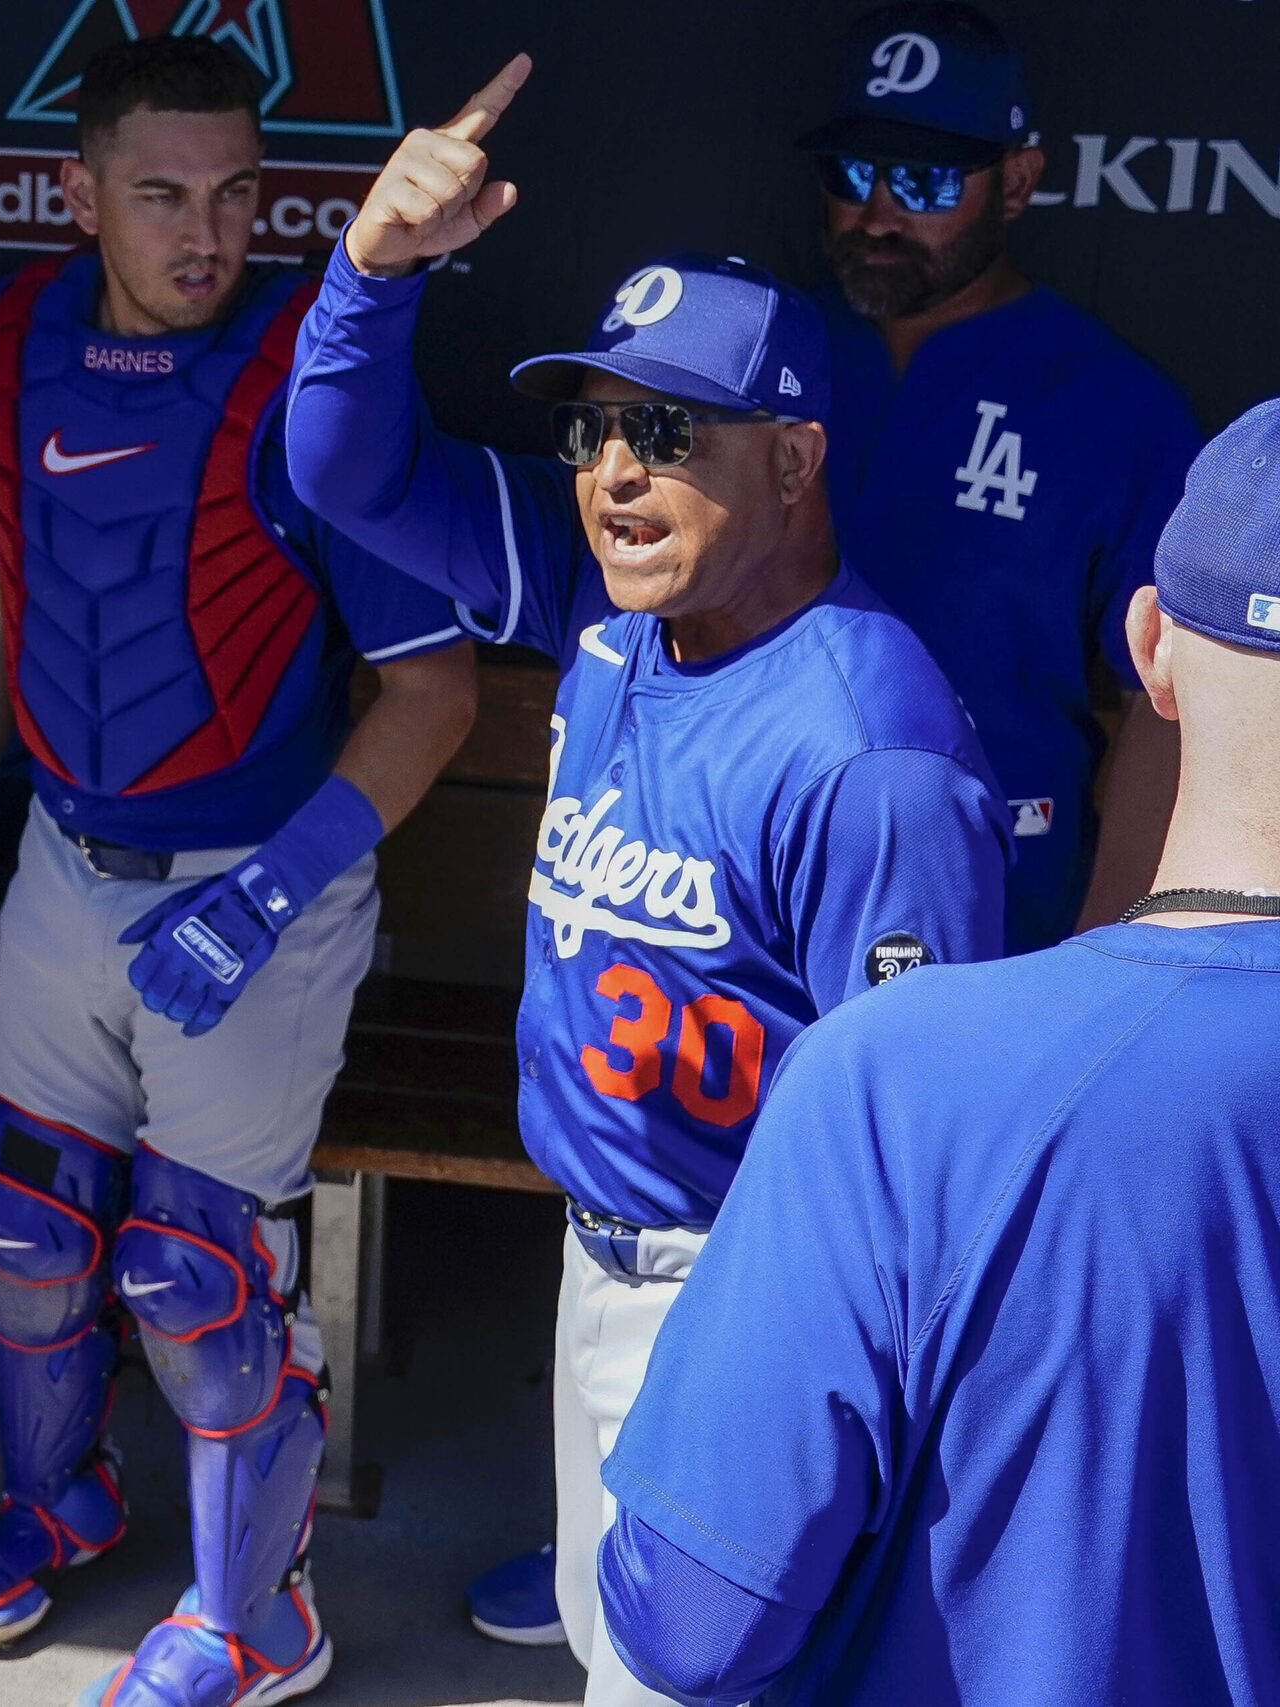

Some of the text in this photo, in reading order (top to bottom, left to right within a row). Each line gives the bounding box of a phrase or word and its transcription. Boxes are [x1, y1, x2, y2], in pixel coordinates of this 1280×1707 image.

[865, 32, 941, 98] D
[602, 264, 684, 334] D
[84, 344, 175, 374] BARNES
[954, 400, 1038, 521] LA
[875, 946, 923, 959] FERNANDO
[579, 962, 765, 1128] 30
